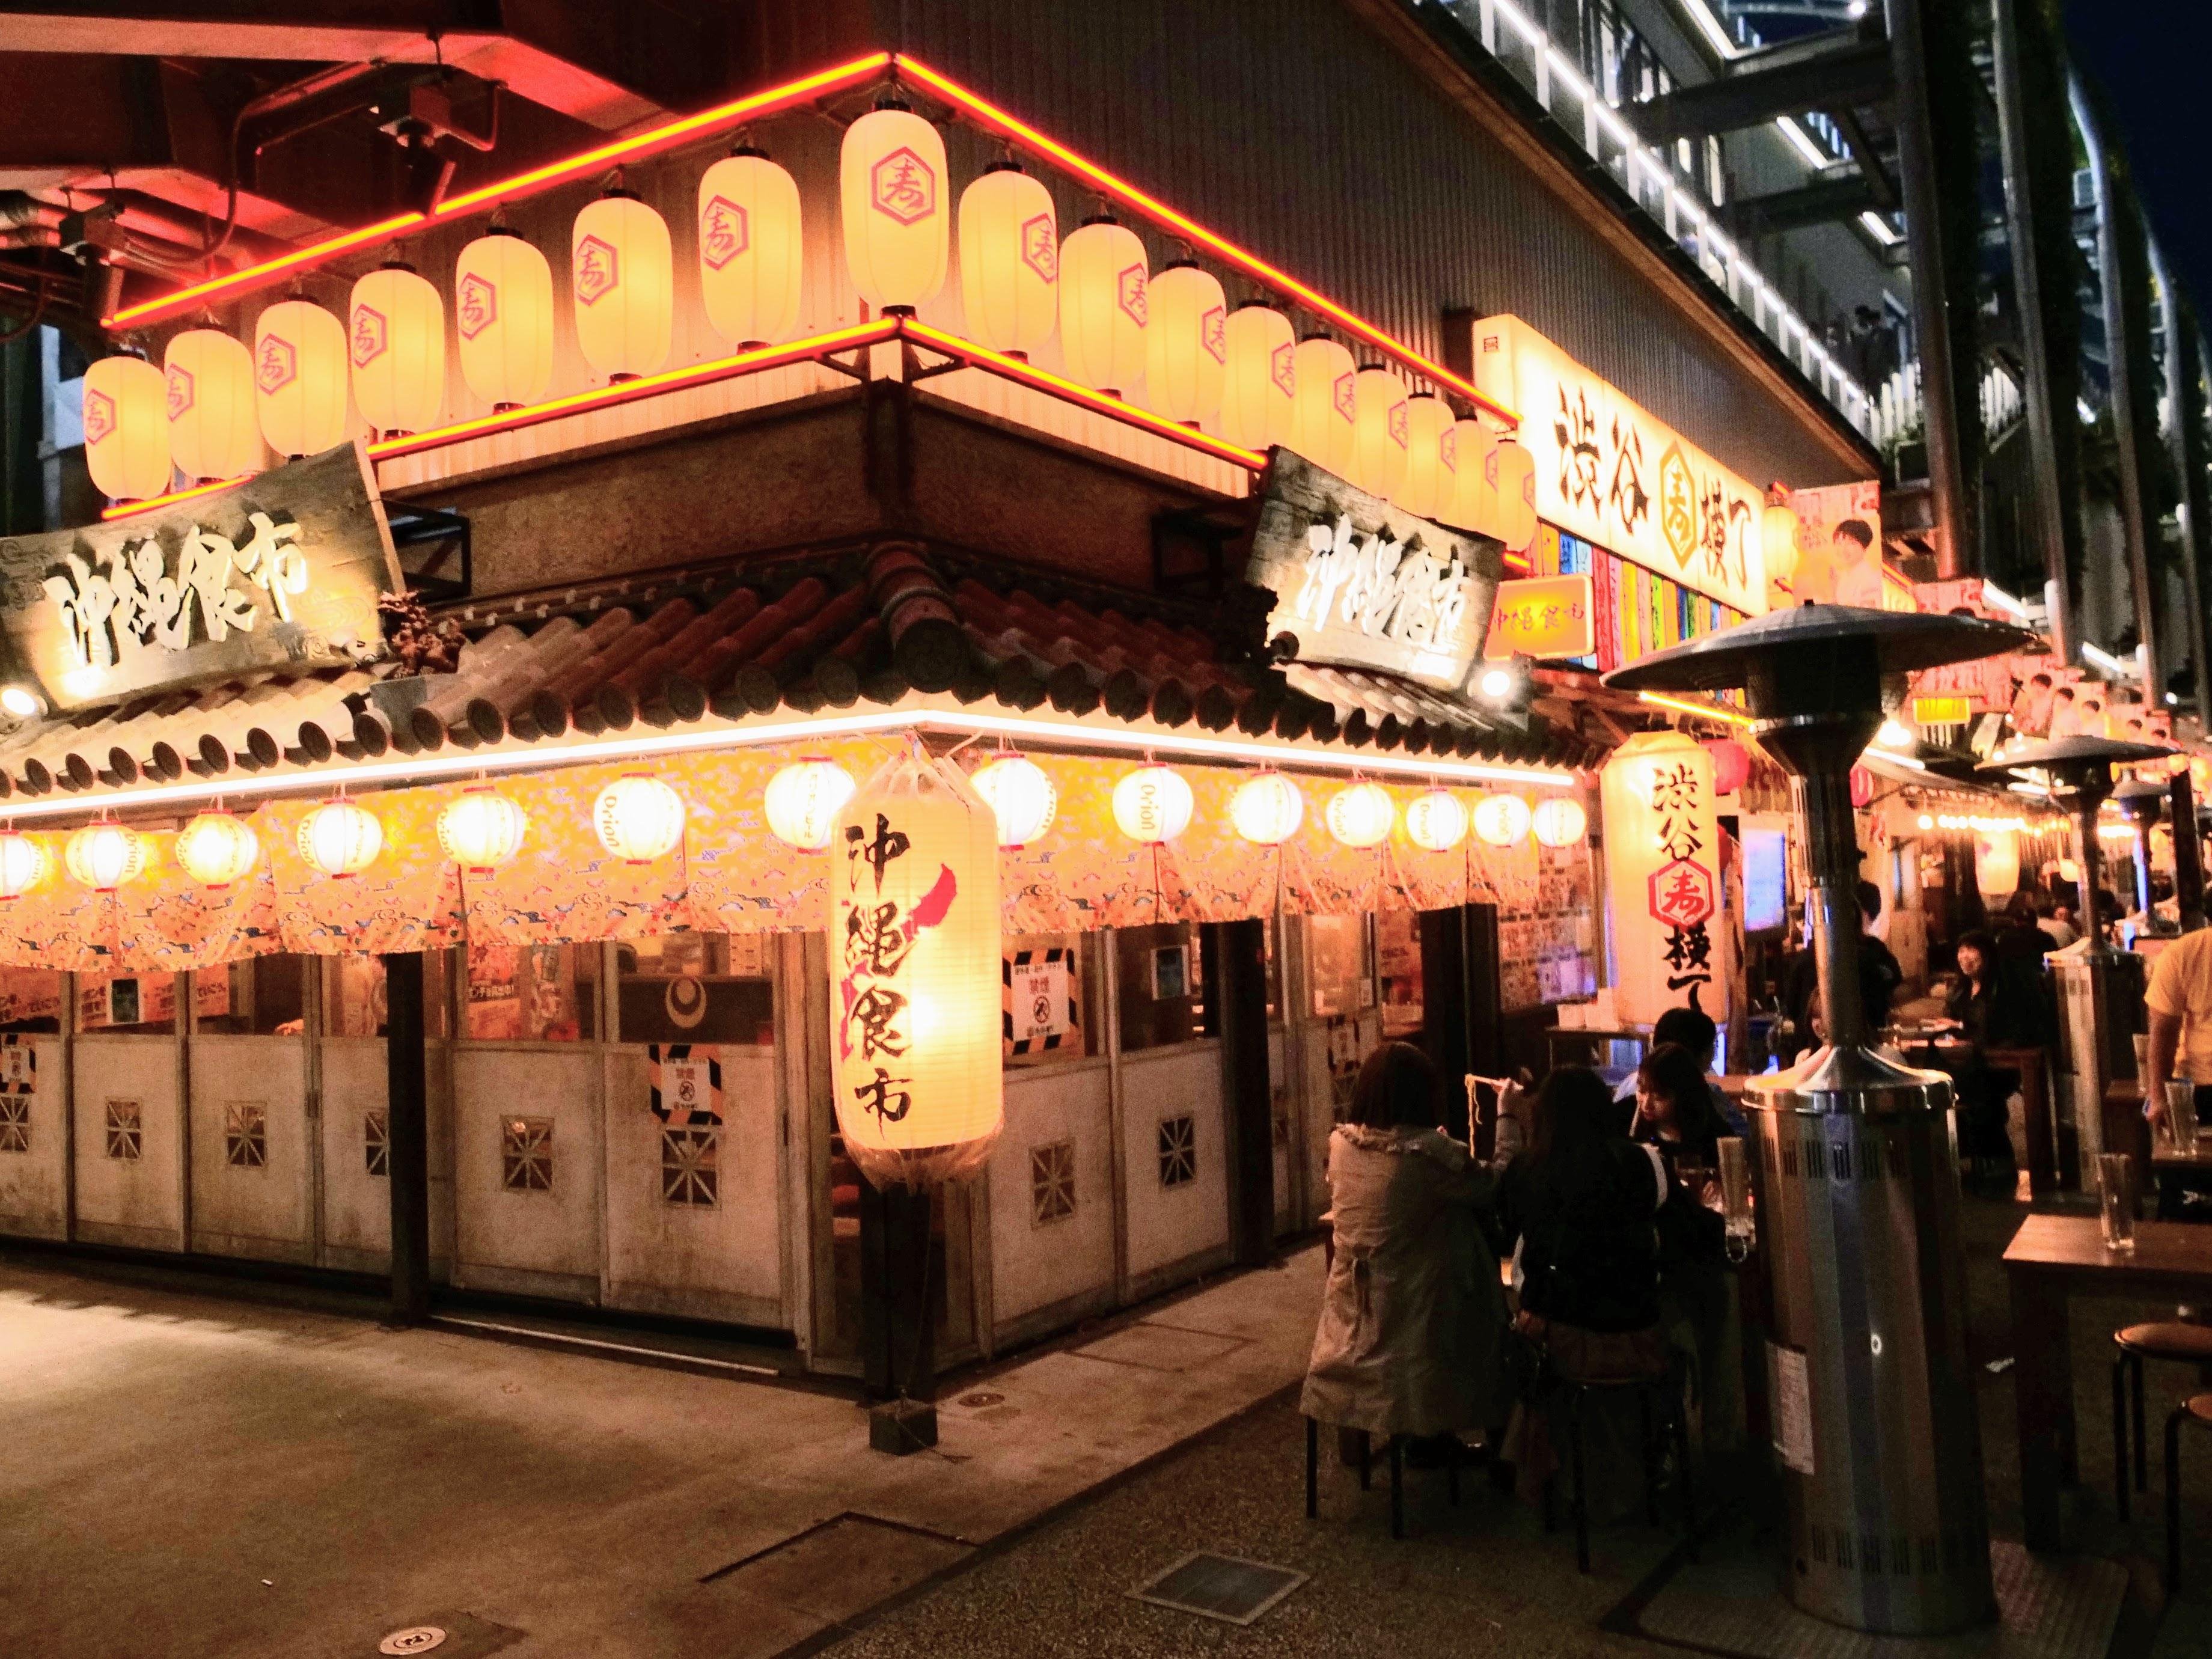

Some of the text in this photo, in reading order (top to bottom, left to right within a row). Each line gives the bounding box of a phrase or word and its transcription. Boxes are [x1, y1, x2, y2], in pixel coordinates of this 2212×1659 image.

[1554, 382, 1649, 536] 渋谷
[1701, 473, 1752, 590] 横丁
[602, 795, 620, 848] Orion
[1141, 784, 1159, 830] Orion
[1652, 763, 1702, 861] 渋谷
[124, 833, 141, 874] Orion
[845, 813, 914, 1140] 沖縄食市
[1663, 924, 1711, 1012] 横丁
